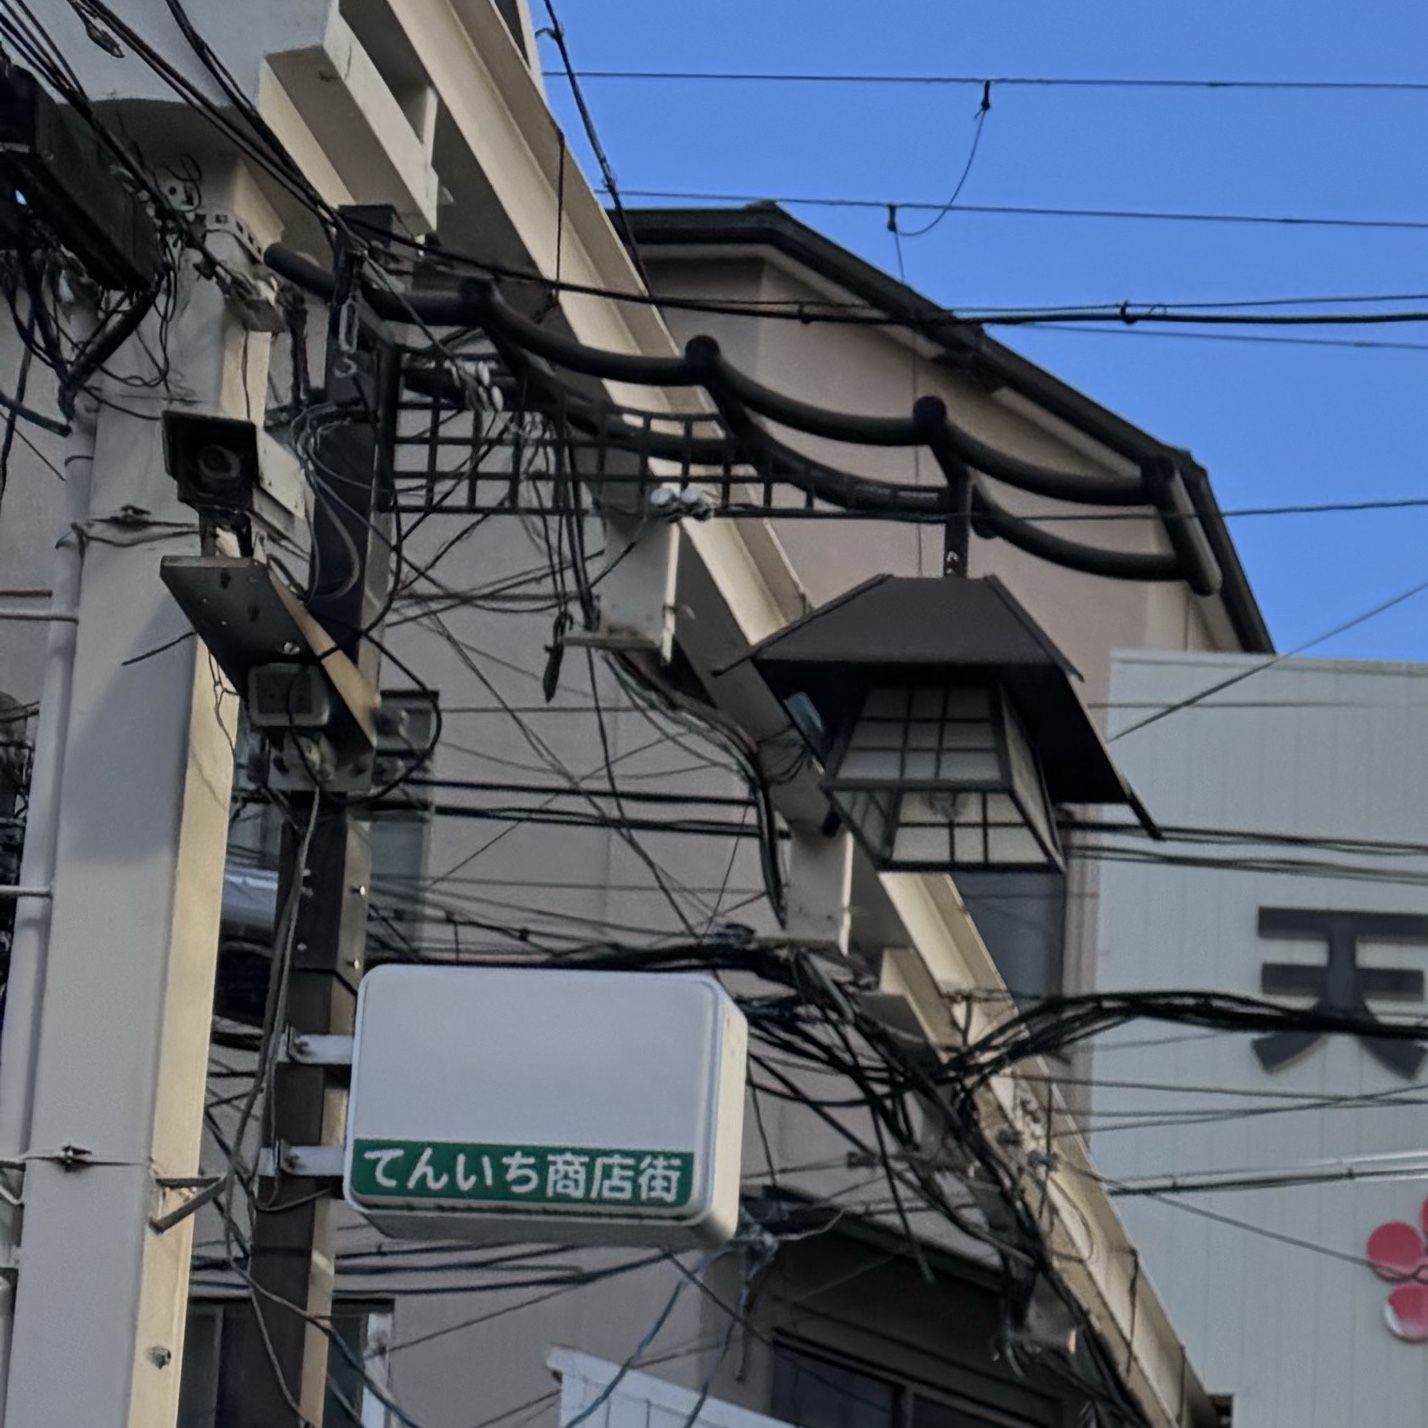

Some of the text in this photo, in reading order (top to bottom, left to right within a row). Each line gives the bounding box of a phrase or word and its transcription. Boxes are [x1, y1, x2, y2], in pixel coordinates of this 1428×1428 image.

[362, 1146, 682, 1204] てんいち商店街
